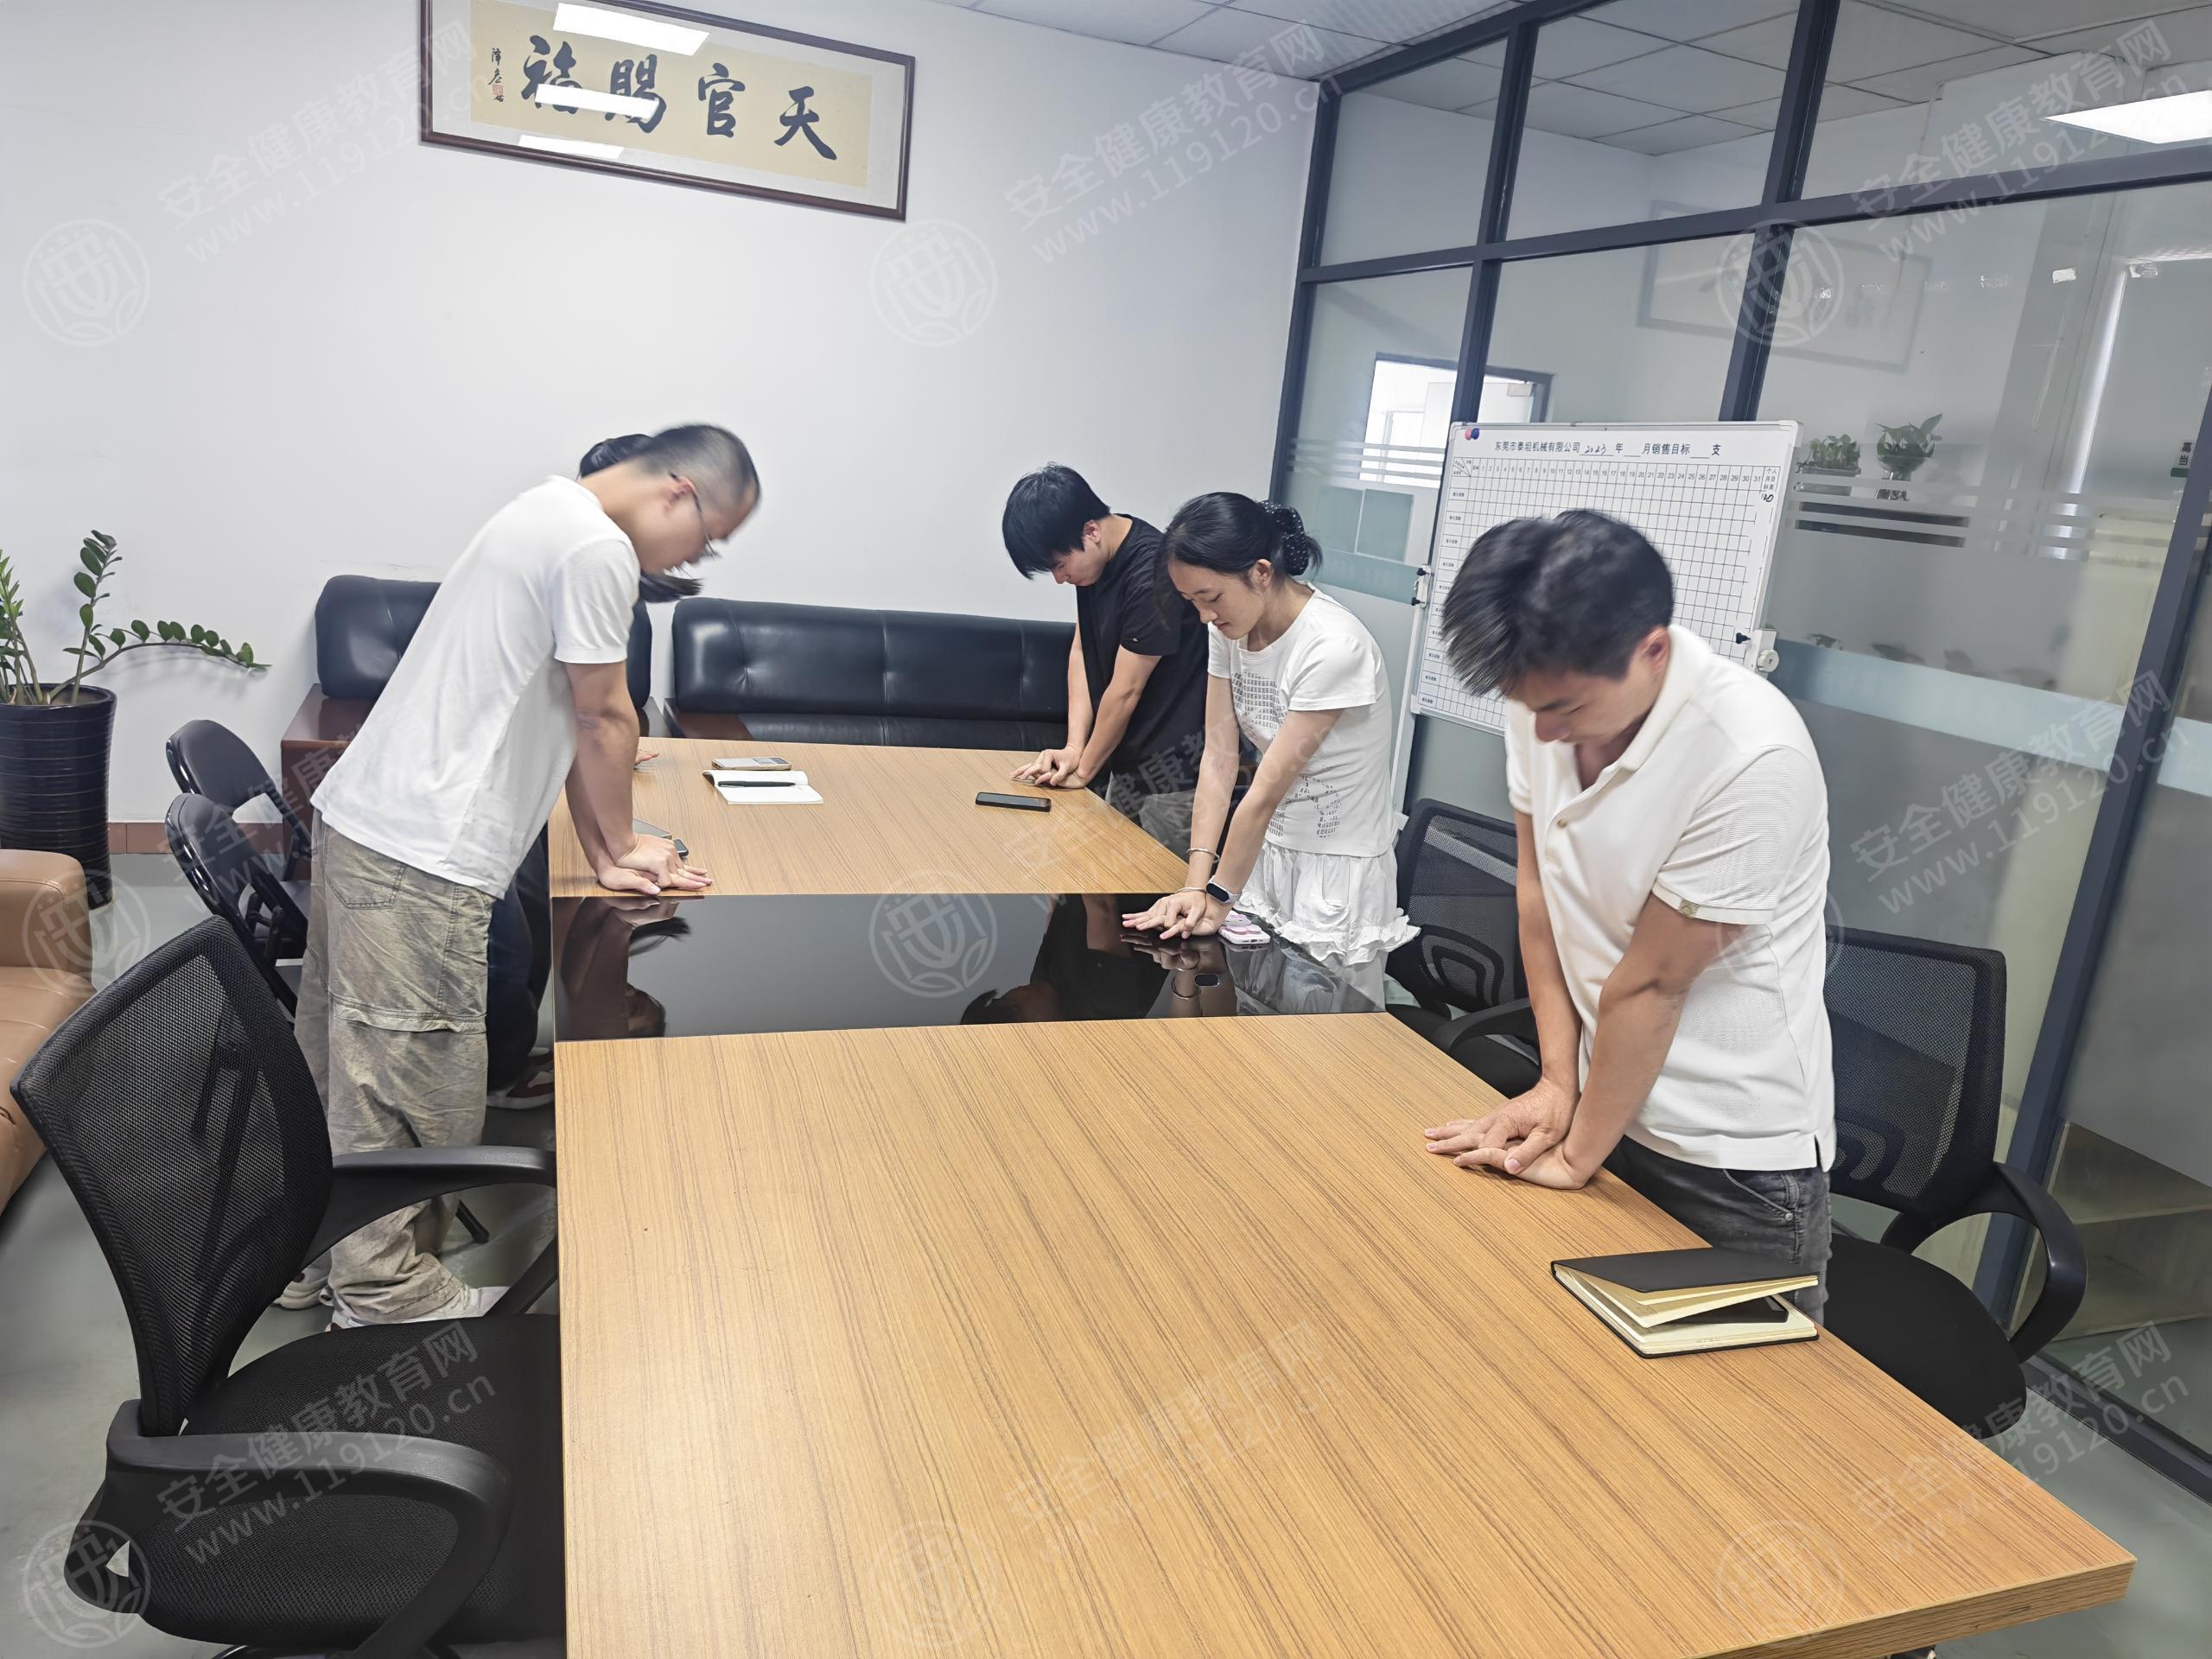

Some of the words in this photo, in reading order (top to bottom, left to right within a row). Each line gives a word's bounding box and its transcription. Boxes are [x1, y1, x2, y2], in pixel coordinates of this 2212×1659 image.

[1615, 442, 1624, 454] 年
[1643, 442, 1691, 455] 月销售目标
[1711, 443, 1721, 455] 支
